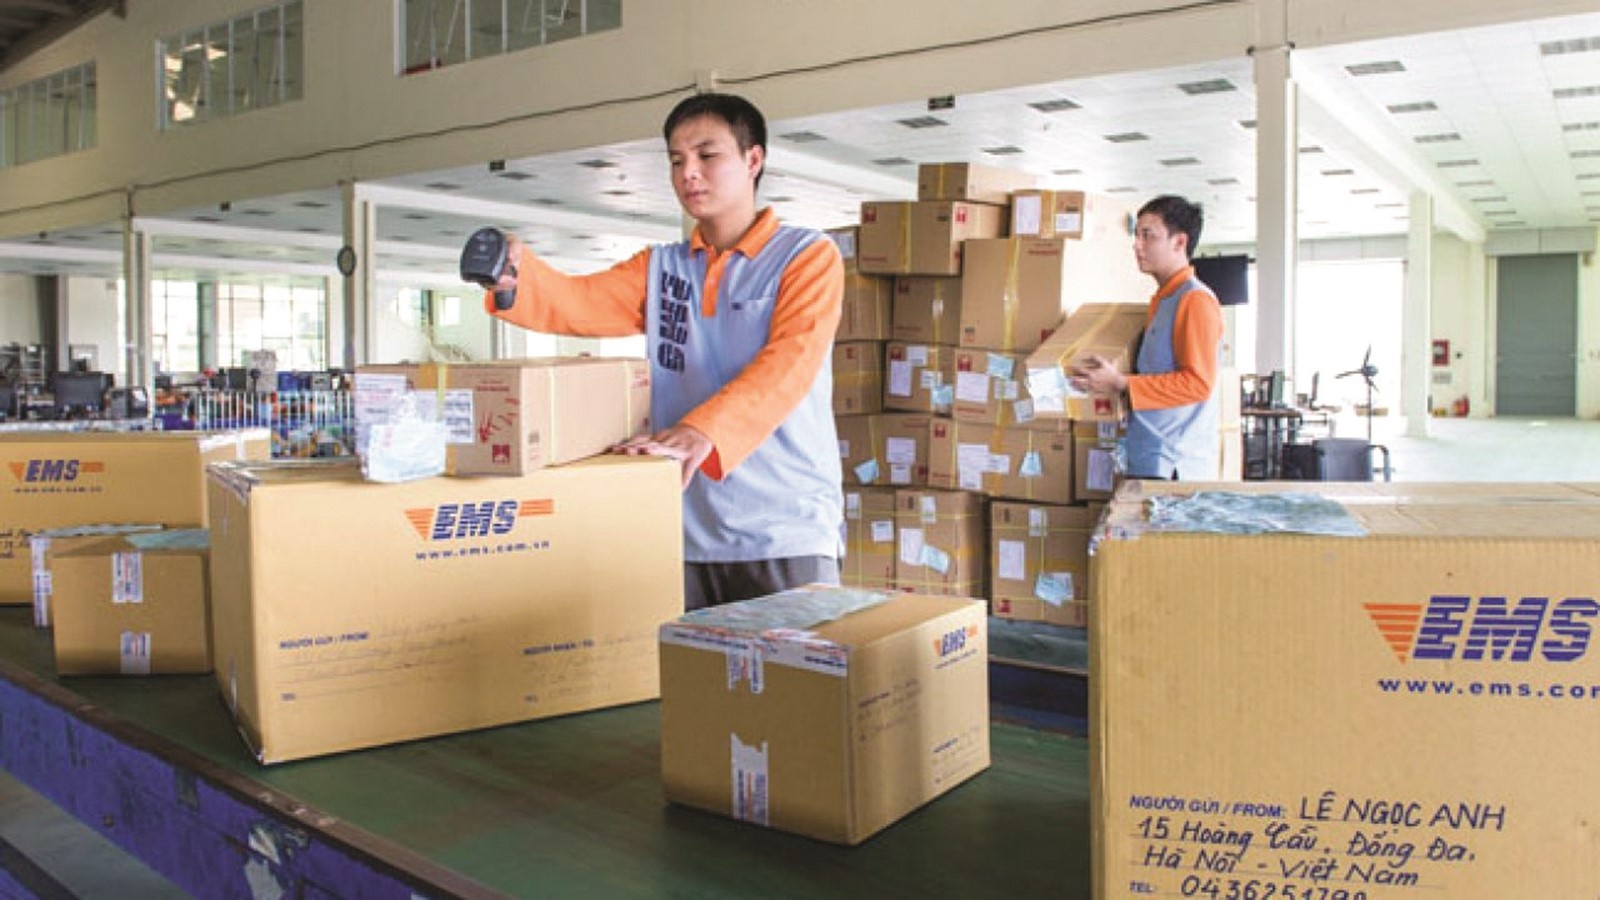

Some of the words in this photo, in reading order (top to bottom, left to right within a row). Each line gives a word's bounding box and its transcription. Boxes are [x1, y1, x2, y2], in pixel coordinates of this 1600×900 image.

[24, 459, 80, 482] EMS
[432, 499, 518, 540] EMS
[1412, 595, 1600, 662] EMS
[1300, 791, 1337, 820] LÊ
[1342, 798, 1422, 834] NGỌC
[1429, 802, 1507, 831] ANH
[1138, 815, 1170, 840] 15
[1181, 819, 1253, 861] Hoàng
[1346, 829, 1416, 869] Đống
[1143, 845, 1187, 869] Hà
[1279, 856, 1339, 885] Việt
[1344, 861, 1419, 887] Nam
